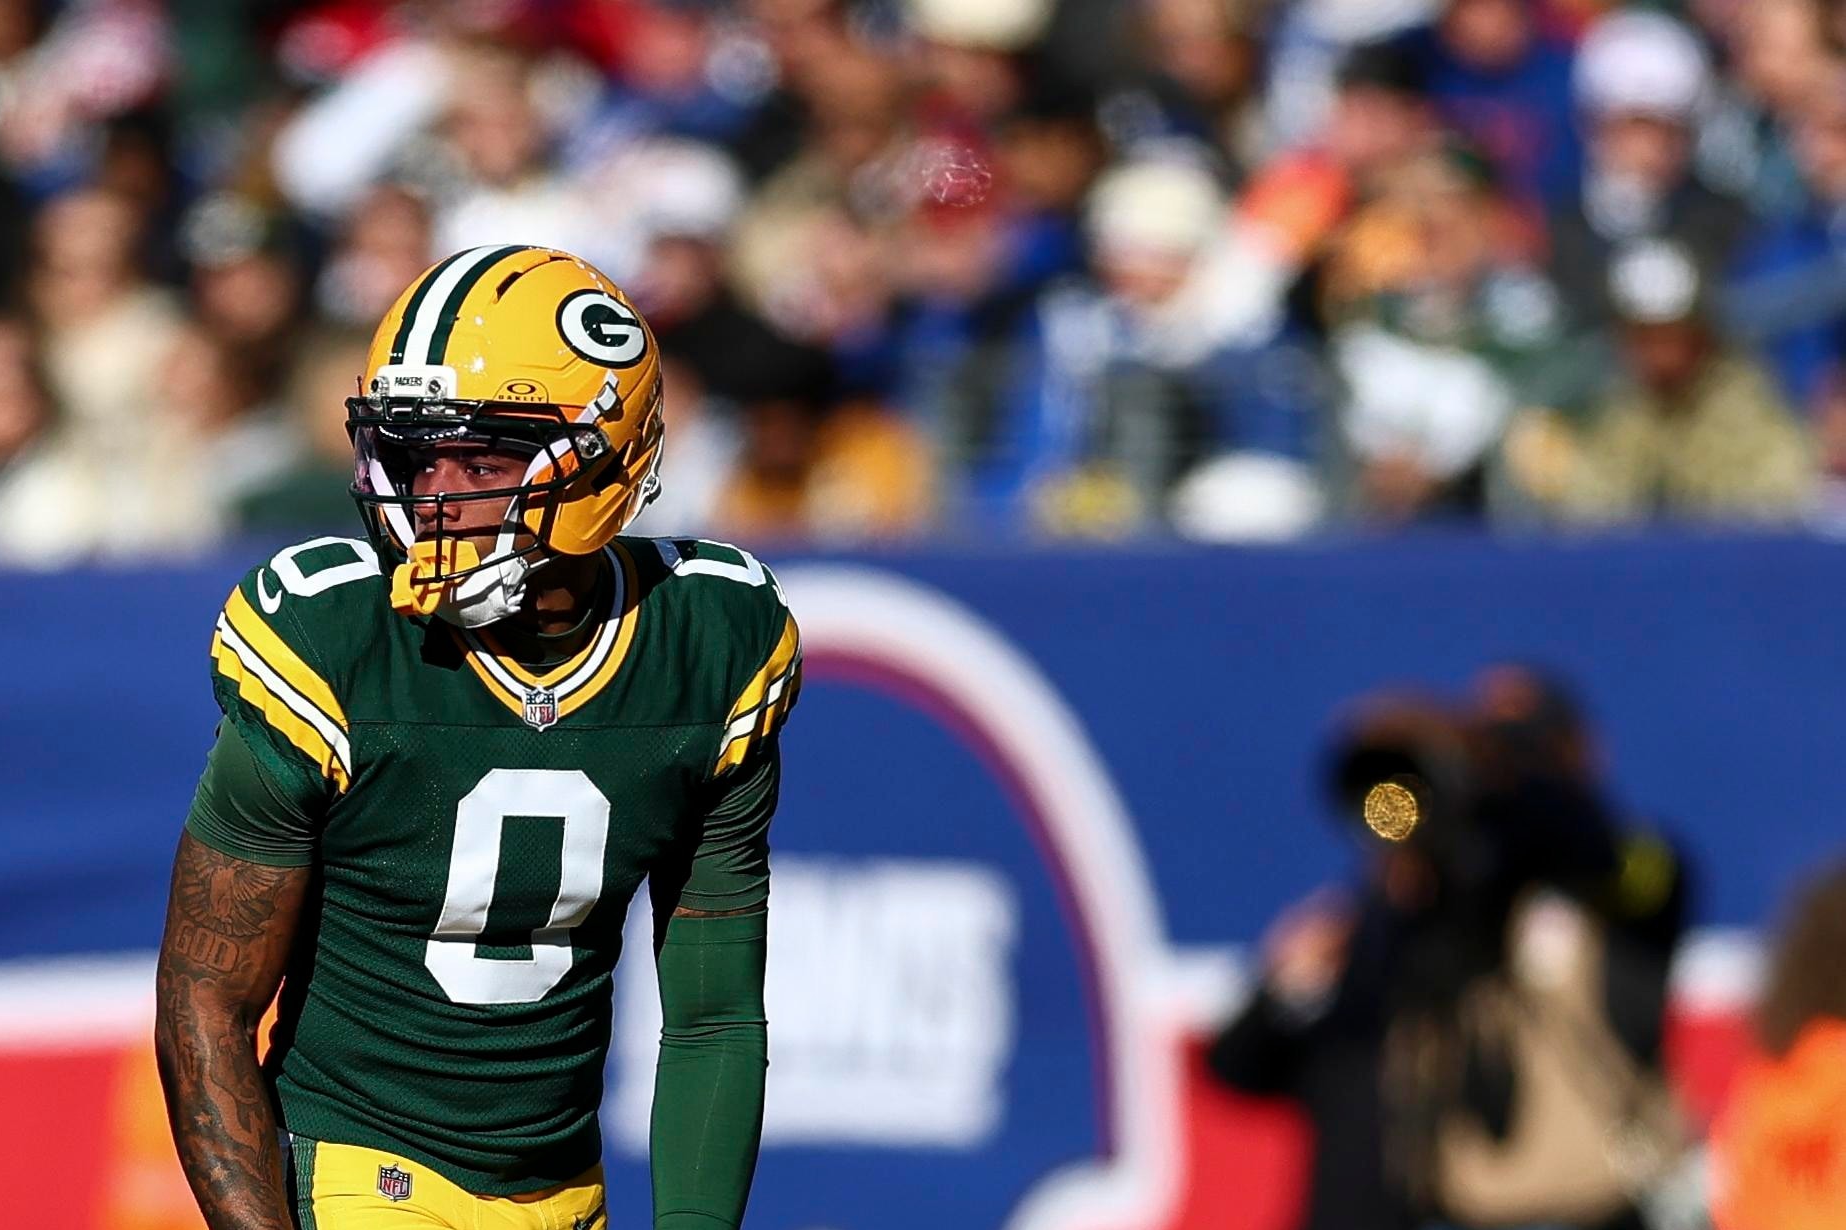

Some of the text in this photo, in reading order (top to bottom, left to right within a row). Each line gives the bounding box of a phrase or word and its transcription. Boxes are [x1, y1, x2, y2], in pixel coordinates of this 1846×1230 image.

[557, 290, 646, 366] G
[394, 376, 423, 387] PACKERS
[498, 394, 545, 402] OAKLEY
[526, 703, 554, 723] NFL
[424, 768, 611, 1005] 0
[174, 919, 240, 973] GOD
[381, 1177, 408, 1196] NFL
